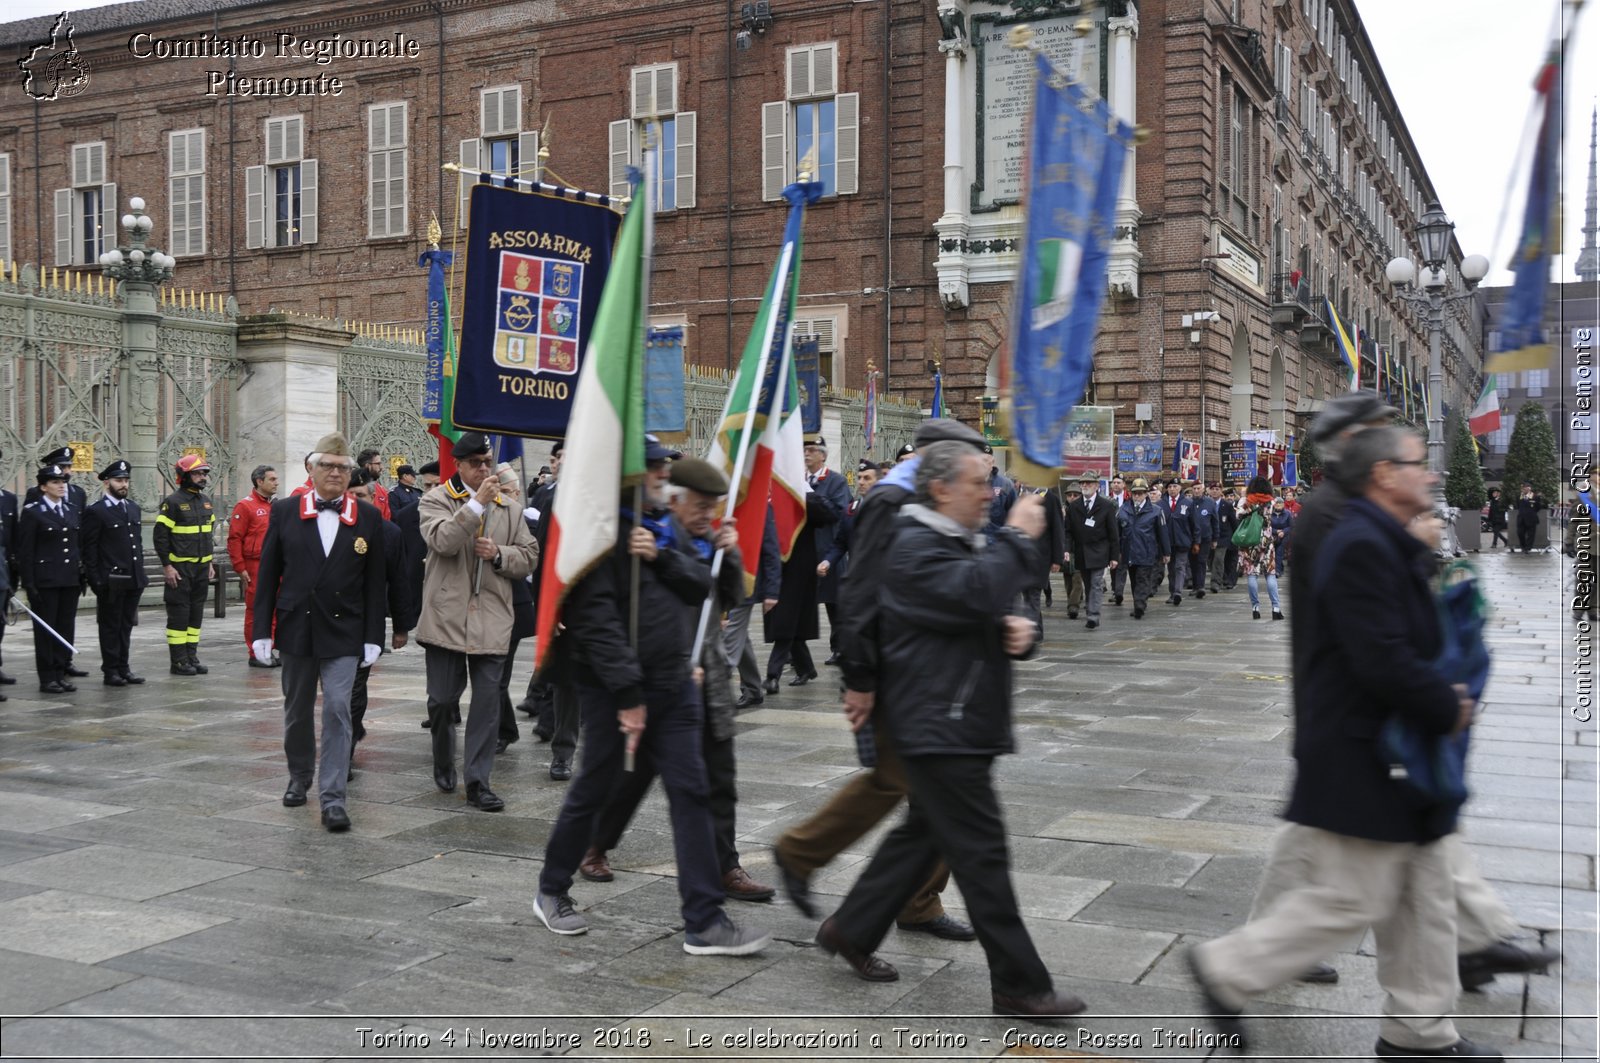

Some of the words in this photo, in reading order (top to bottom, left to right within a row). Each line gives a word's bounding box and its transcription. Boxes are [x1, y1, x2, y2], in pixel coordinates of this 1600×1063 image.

[488, 230, 592, 265] ASSOARMA
[430, 300, 440, 341] TORINO
[430, 348, 440, 381] PROV.
[497, 374, 569, 401] TORINO
